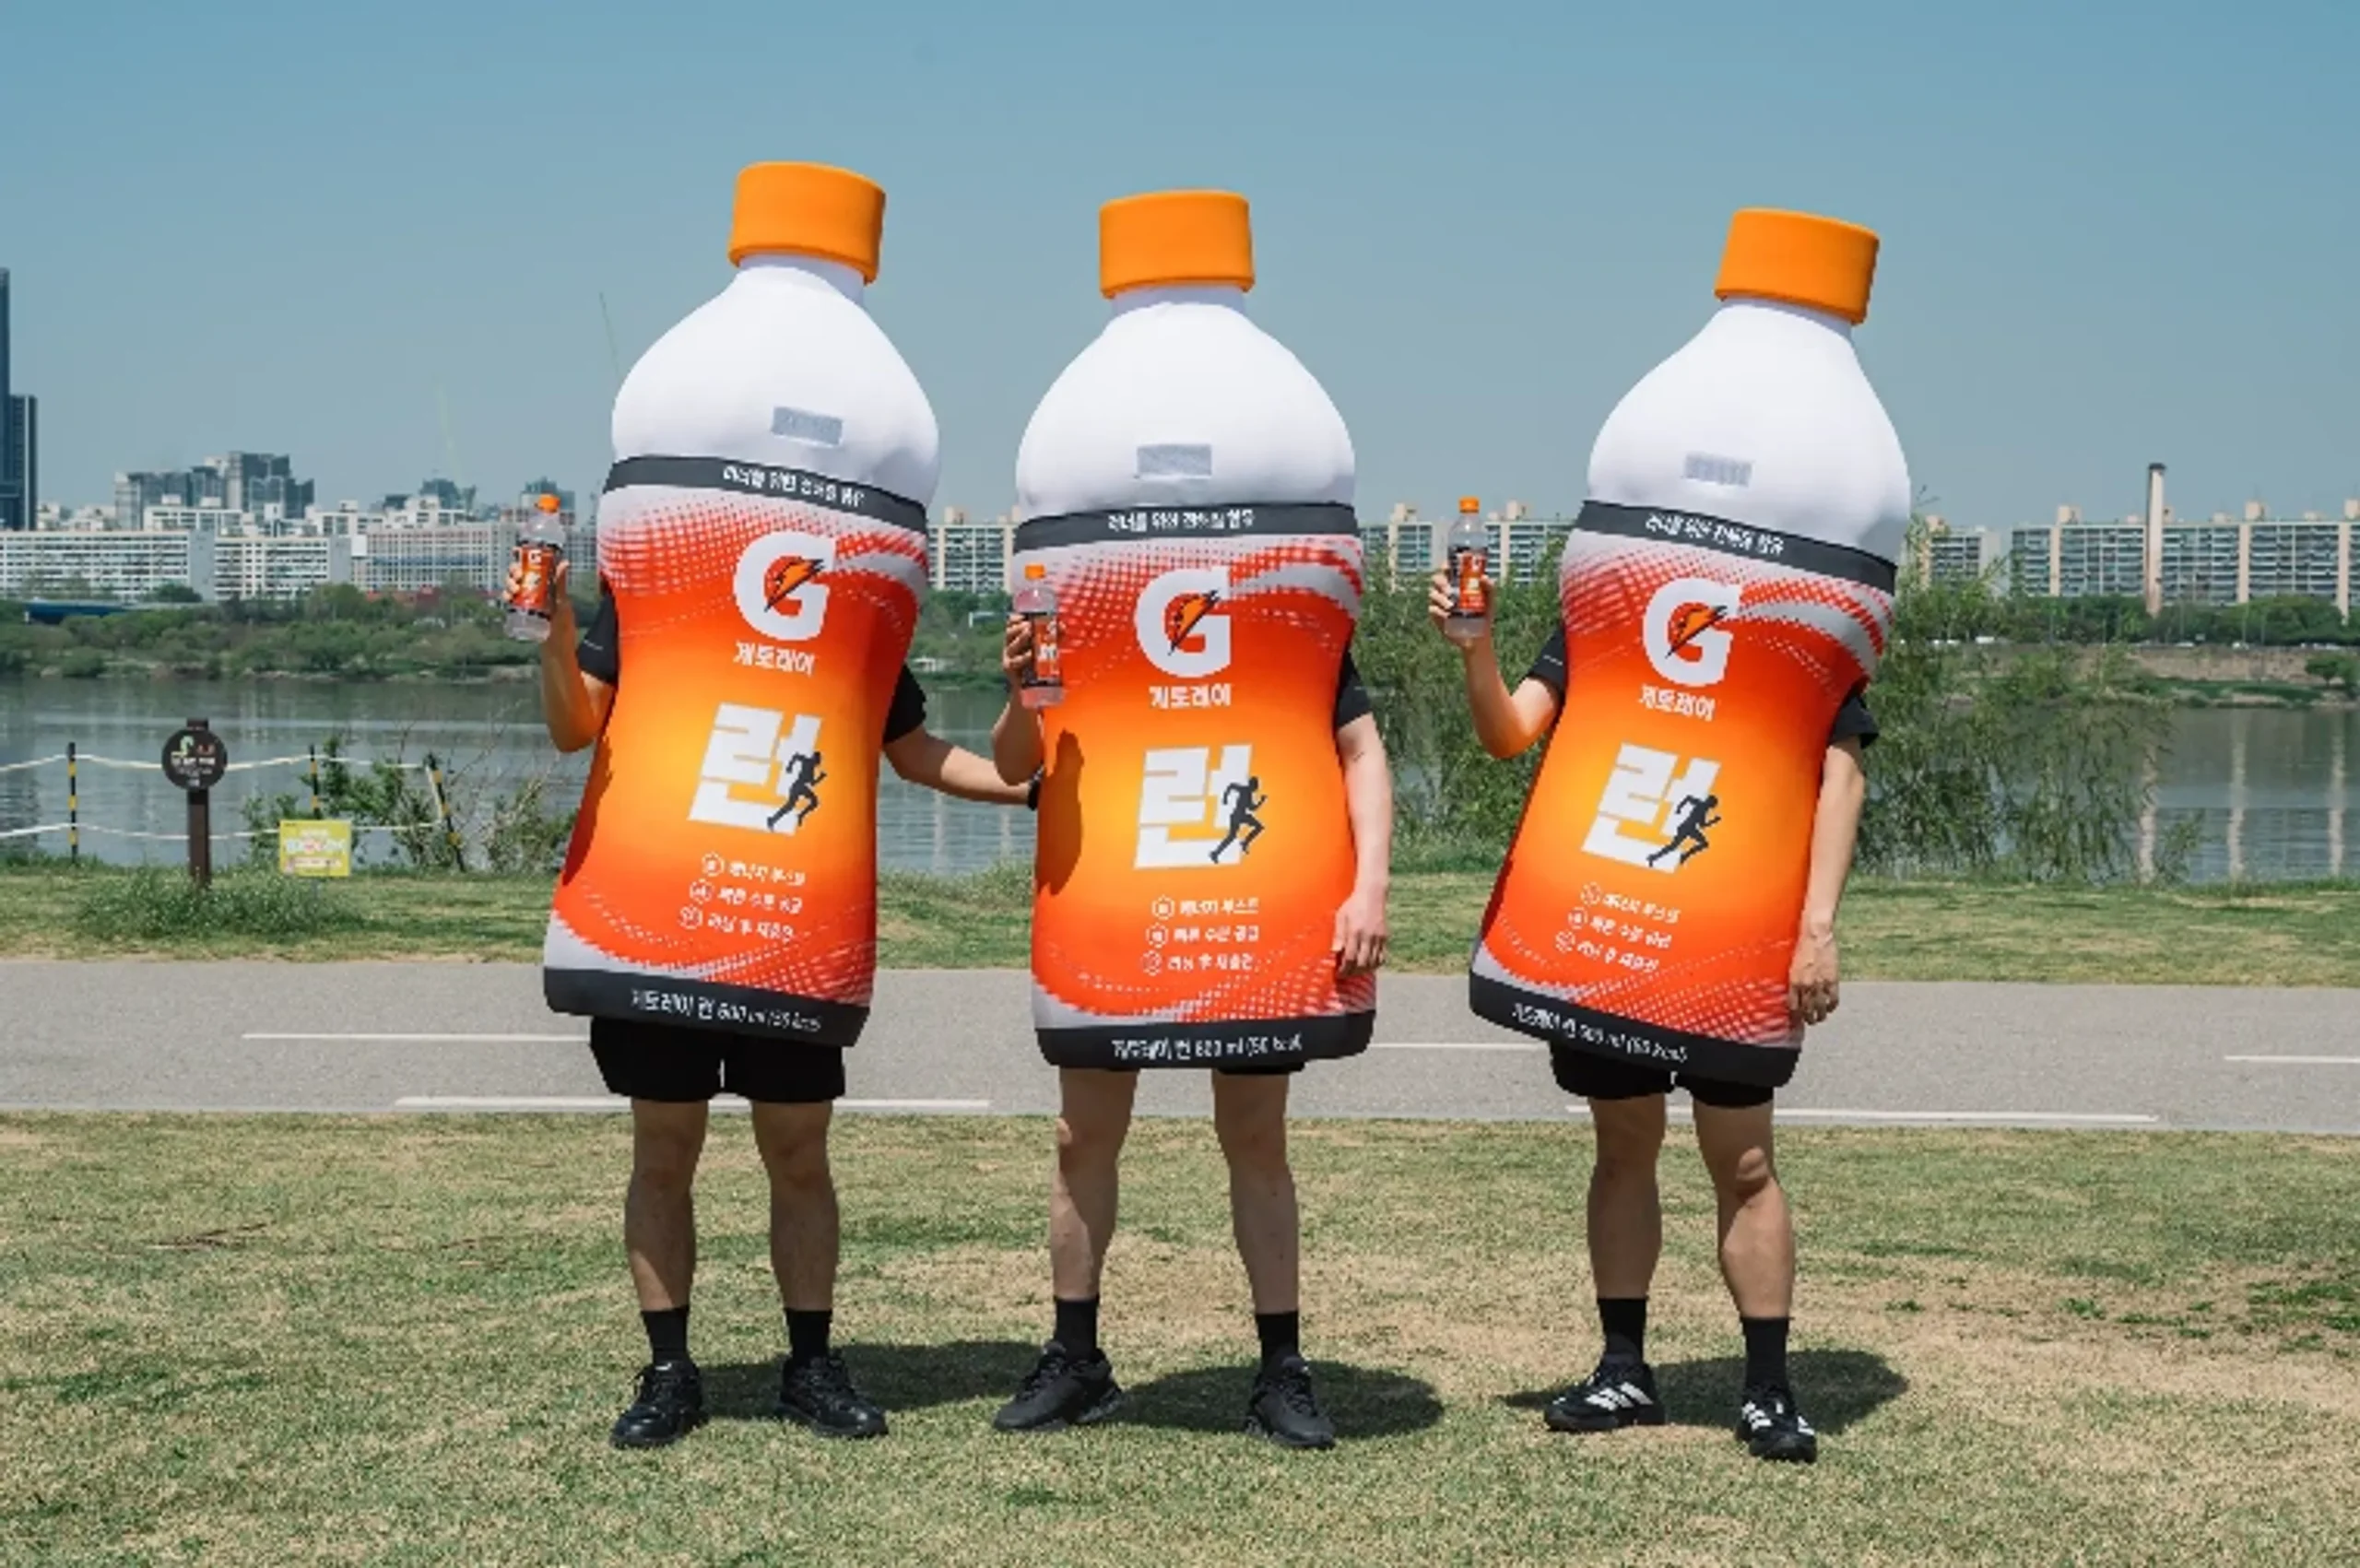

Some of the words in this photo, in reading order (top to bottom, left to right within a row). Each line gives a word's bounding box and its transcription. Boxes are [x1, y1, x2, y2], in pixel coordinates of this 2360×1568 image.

[733, 530, 836, 640] G
[1135, 566, 1232, 678] G
[1643, 577, 1742, 688] G
[733, 640, 814, 676] 게토레이
[1150, 683, 1233, 709] 게토레이
[1639, 683, 1716, 722] 게토레이
[687, 701, 823, 836] 런
[1134, 744, 1254, 871] 런
[1581, 742, 1721, 877] 런
